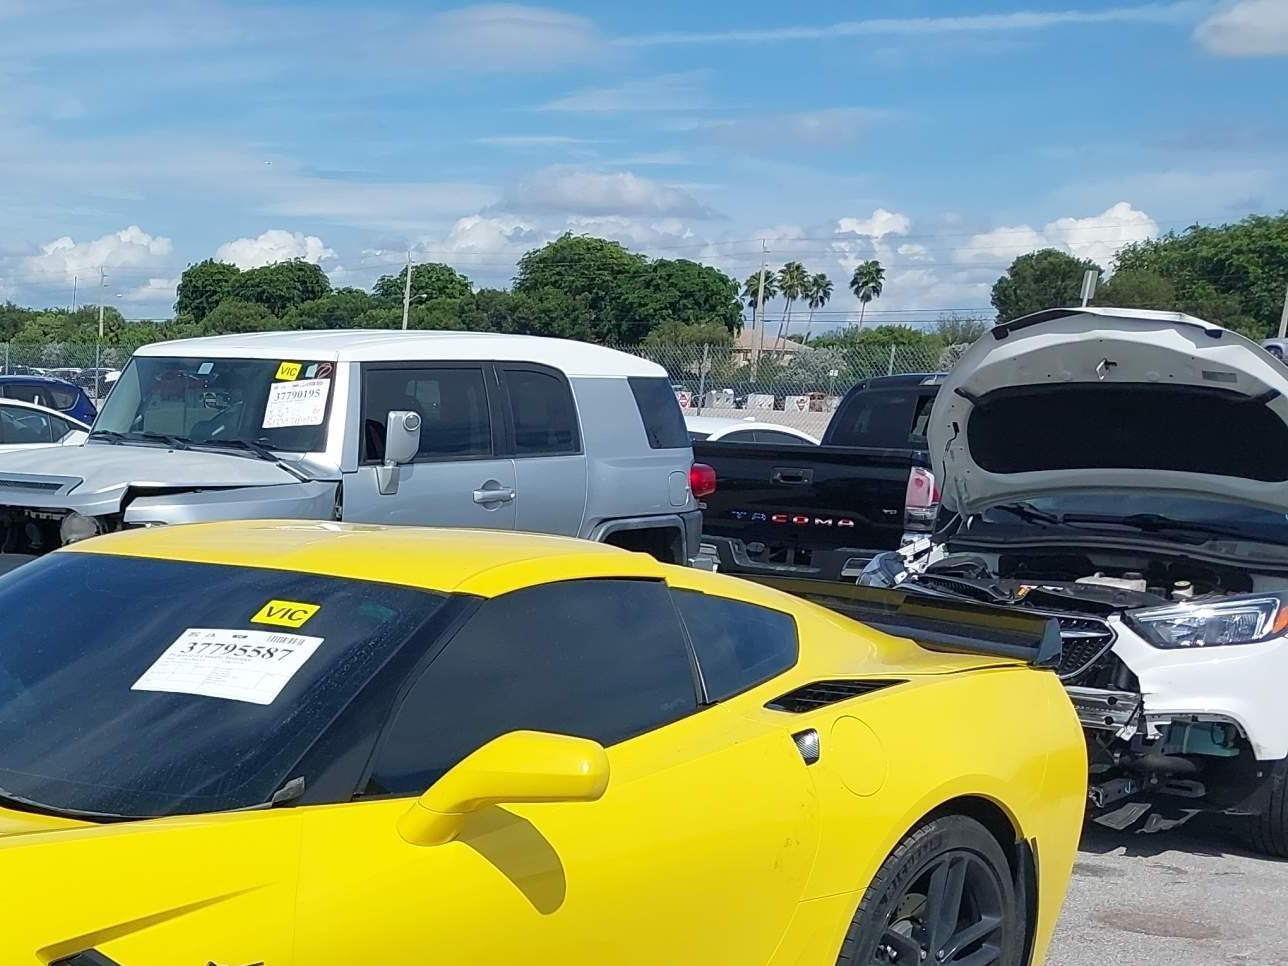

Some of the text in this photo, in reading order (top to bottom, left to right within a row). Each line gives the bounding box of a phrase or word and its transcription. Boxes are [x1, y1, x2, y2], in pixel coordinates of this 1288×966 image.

[280, 365, 298, 377] VIC
[274, 388, 321, 401] 37790195
[731, 510, 855, 527] TACOMA
[264, 605, 309, 622] VIC
[179, 641, 295, 662] 37795587
